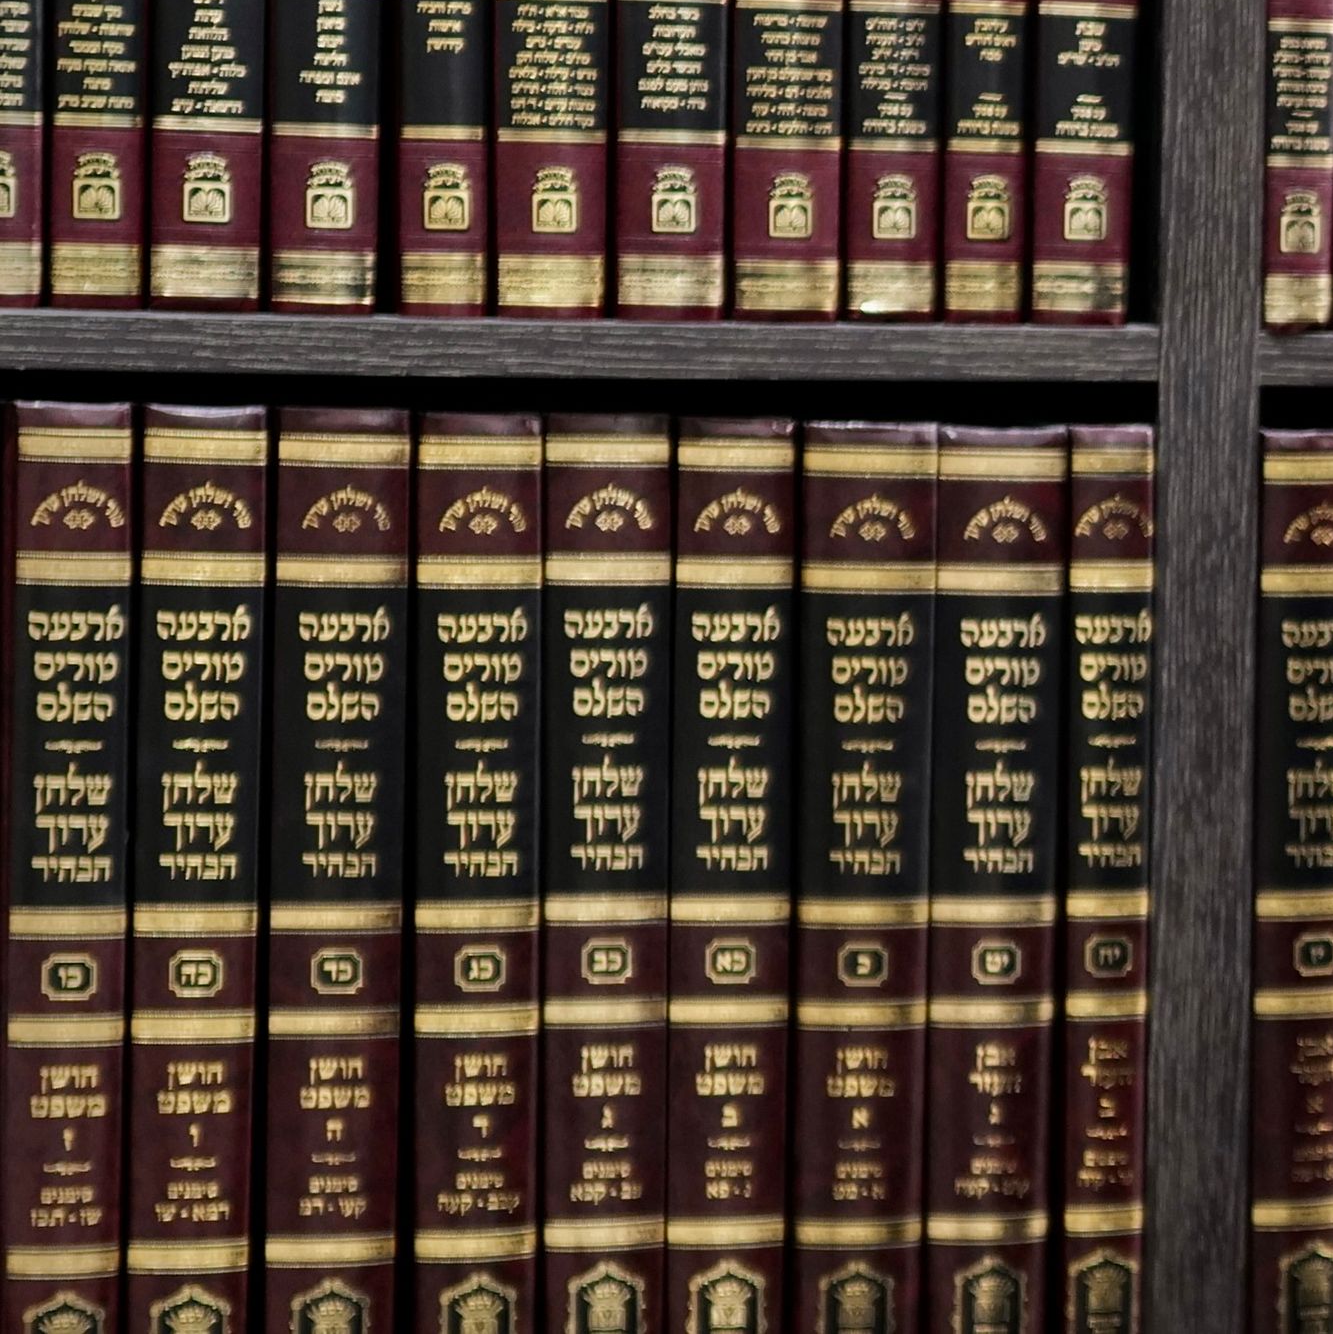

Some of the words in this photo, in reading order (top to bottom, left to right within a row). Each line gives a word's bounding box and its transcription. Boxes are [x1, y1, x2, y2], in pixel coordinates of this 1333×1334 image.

[29, 605, 125, 641] ארבעה
[157, 605, 251, 641] ארבעה
[34, 652, 118, 683] טורים
[162, 652, 244, 682] טורים
[37, 682, 114, 723] השלם
[165, 681, 240, 722] השלם
[34, 763, 112, 813] שלחן
[162, 761, 238, 811] שלחן
[36, 815, 109, 853] ערוך
[164, 813, 234, 851] ערוך
[32, 857, 111, 882] הבהיר
[159, 854, 237, 879] הבהיר
[41, 1065, 99, 1093] חושן
[168, 1062, 223, 1090] חושן
[31, 1095, 106, 1118] משפט
[158, 1091, 231, 1113] משפט
[41, 1187, 94, 1204] סימנים
